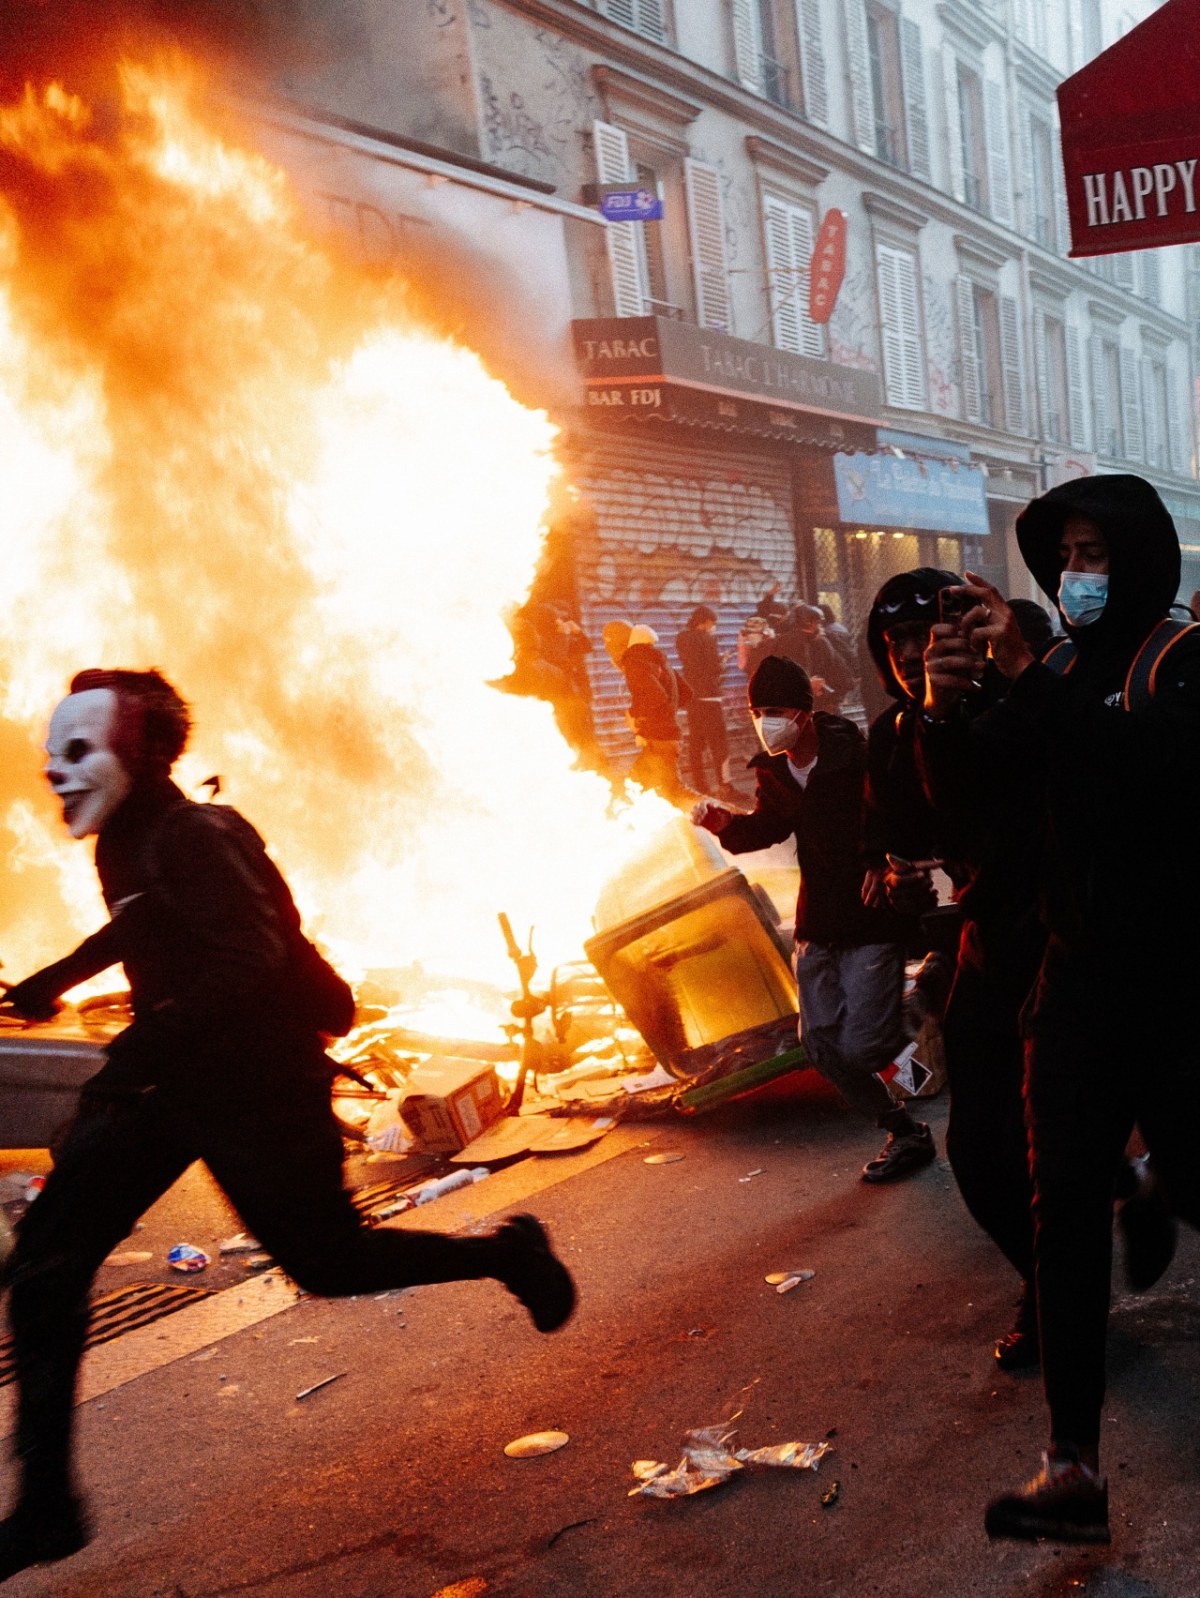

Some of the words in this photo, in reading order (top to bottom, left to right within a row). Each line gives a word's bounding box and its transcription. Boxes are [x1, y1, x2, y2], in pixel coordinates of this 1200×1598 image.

[1083, 158, 1198, 227] HAPPY
[814, 224, 838, 306] TABAC
[583, 338, 657, 360] TABAC
[700, 345, 758, 383] TABAC
[588, 390, 624, 406] BAR
[630, 388, 662, 408] FDJ
